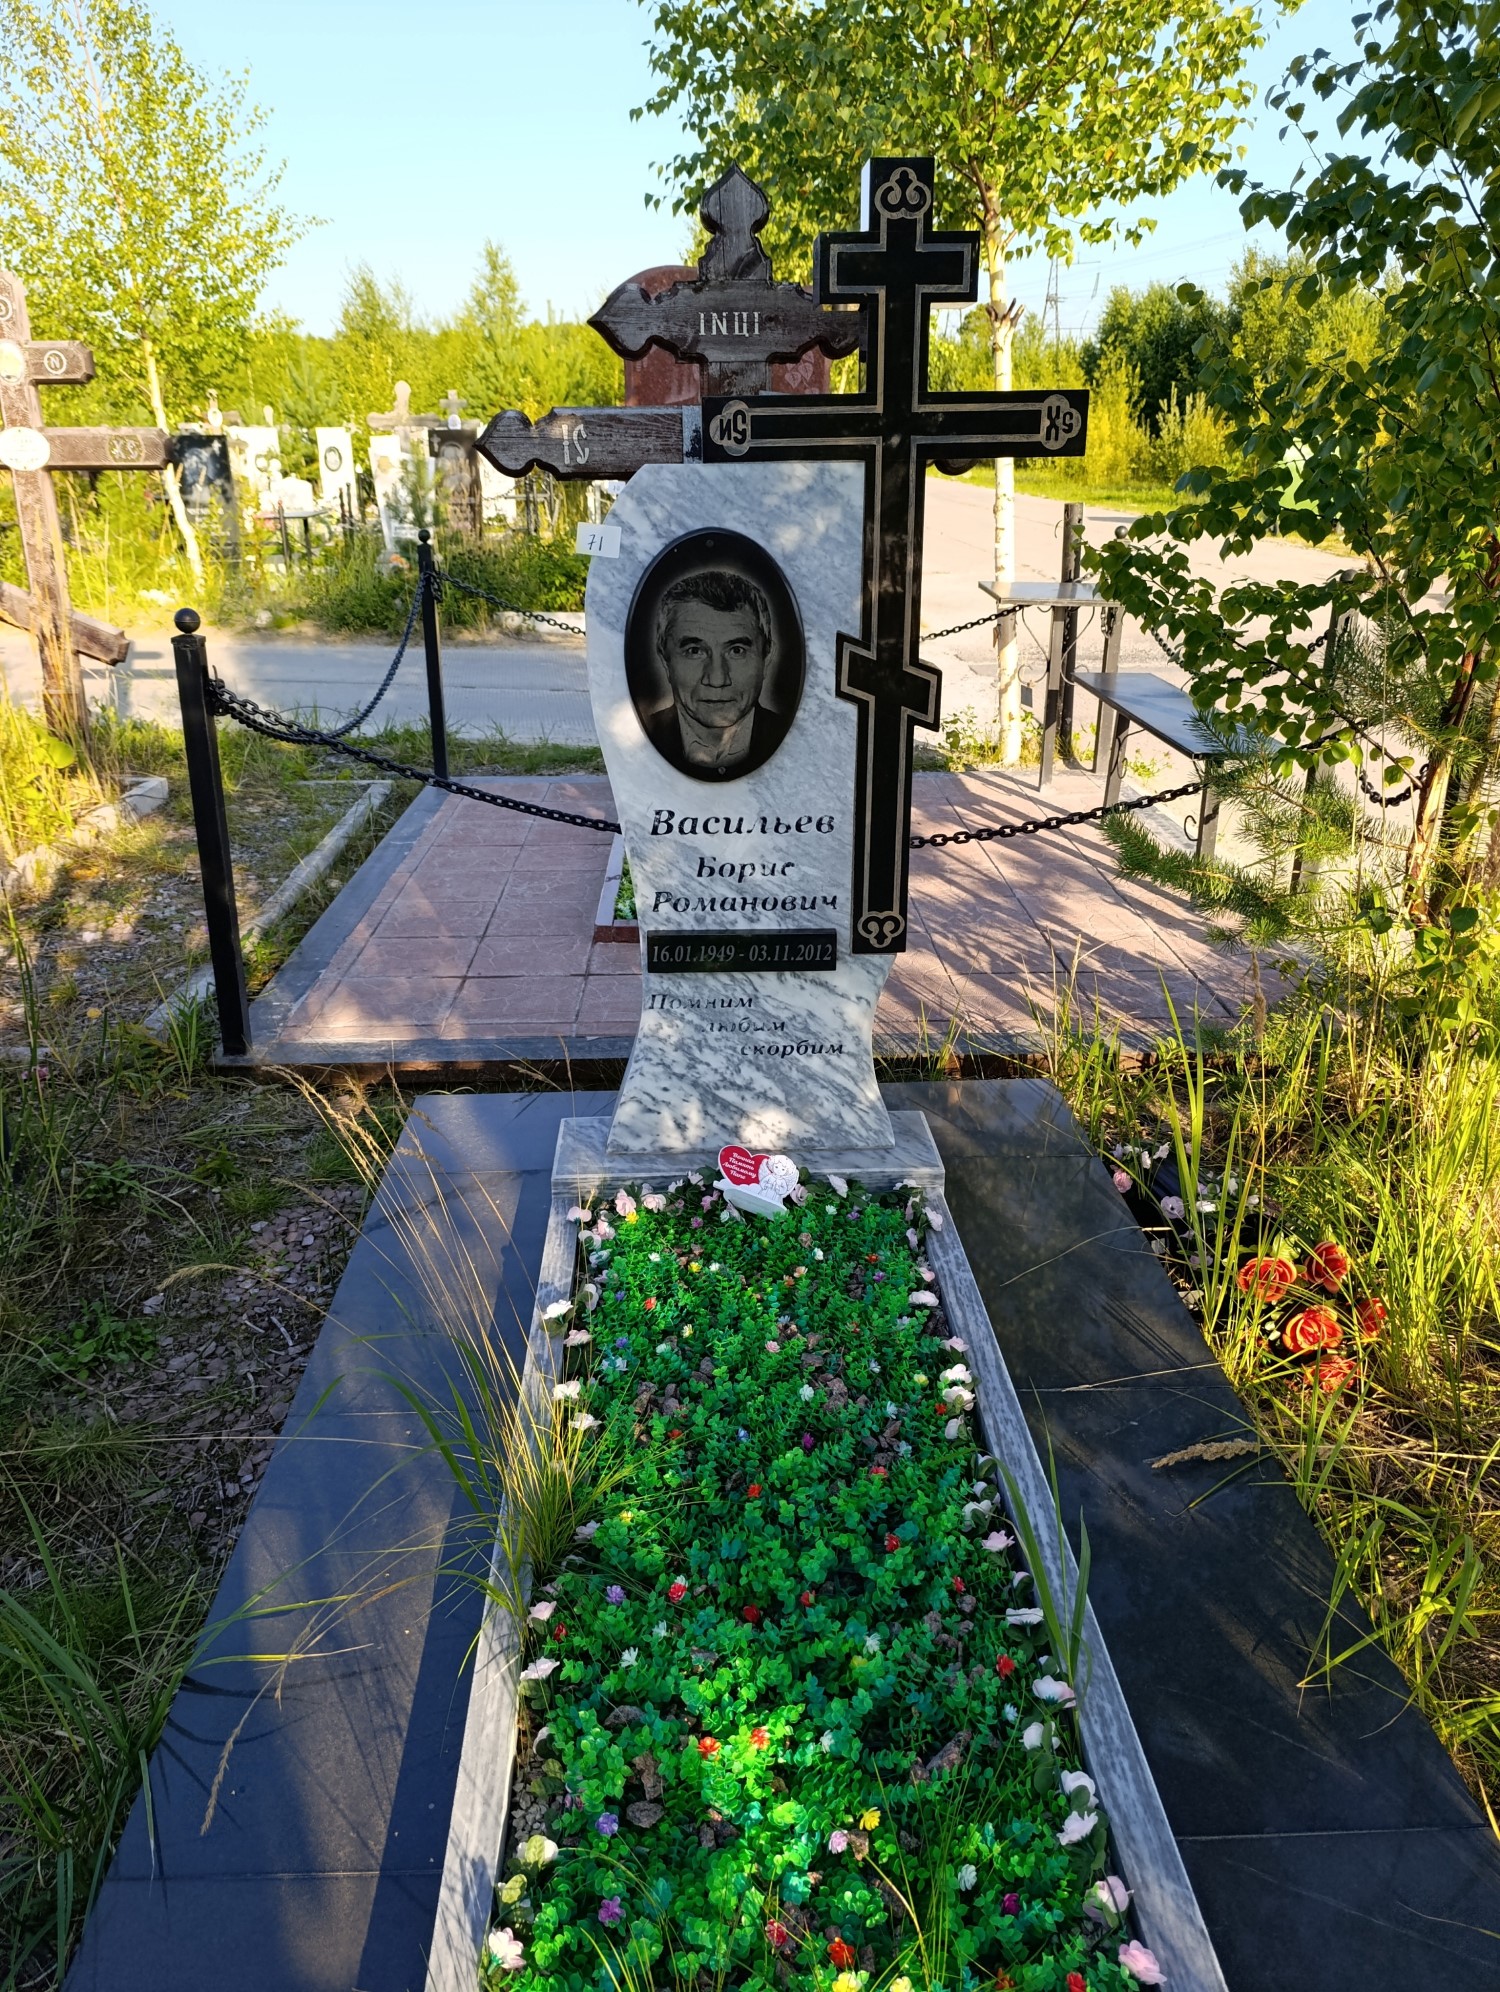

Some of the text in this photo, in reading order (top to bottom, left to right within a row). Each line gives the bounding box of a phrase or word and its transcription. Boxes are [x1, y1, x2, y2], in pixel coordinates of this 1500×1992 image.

[587, 534, 604, 552] 71
[650, 809, 836, 836] Васильев
[696, 856, 796, 884] Борис
[652, 891, 838, 913] Романович
[652, 945, 735, 963] 16.01.1949
[750, 943, 833, 962] 03.11.2012
[649, 993, 753, 1010] Помним
[701, 1016, 786, 1033] любим
[740, 1039, 843, 1059] скорбим
